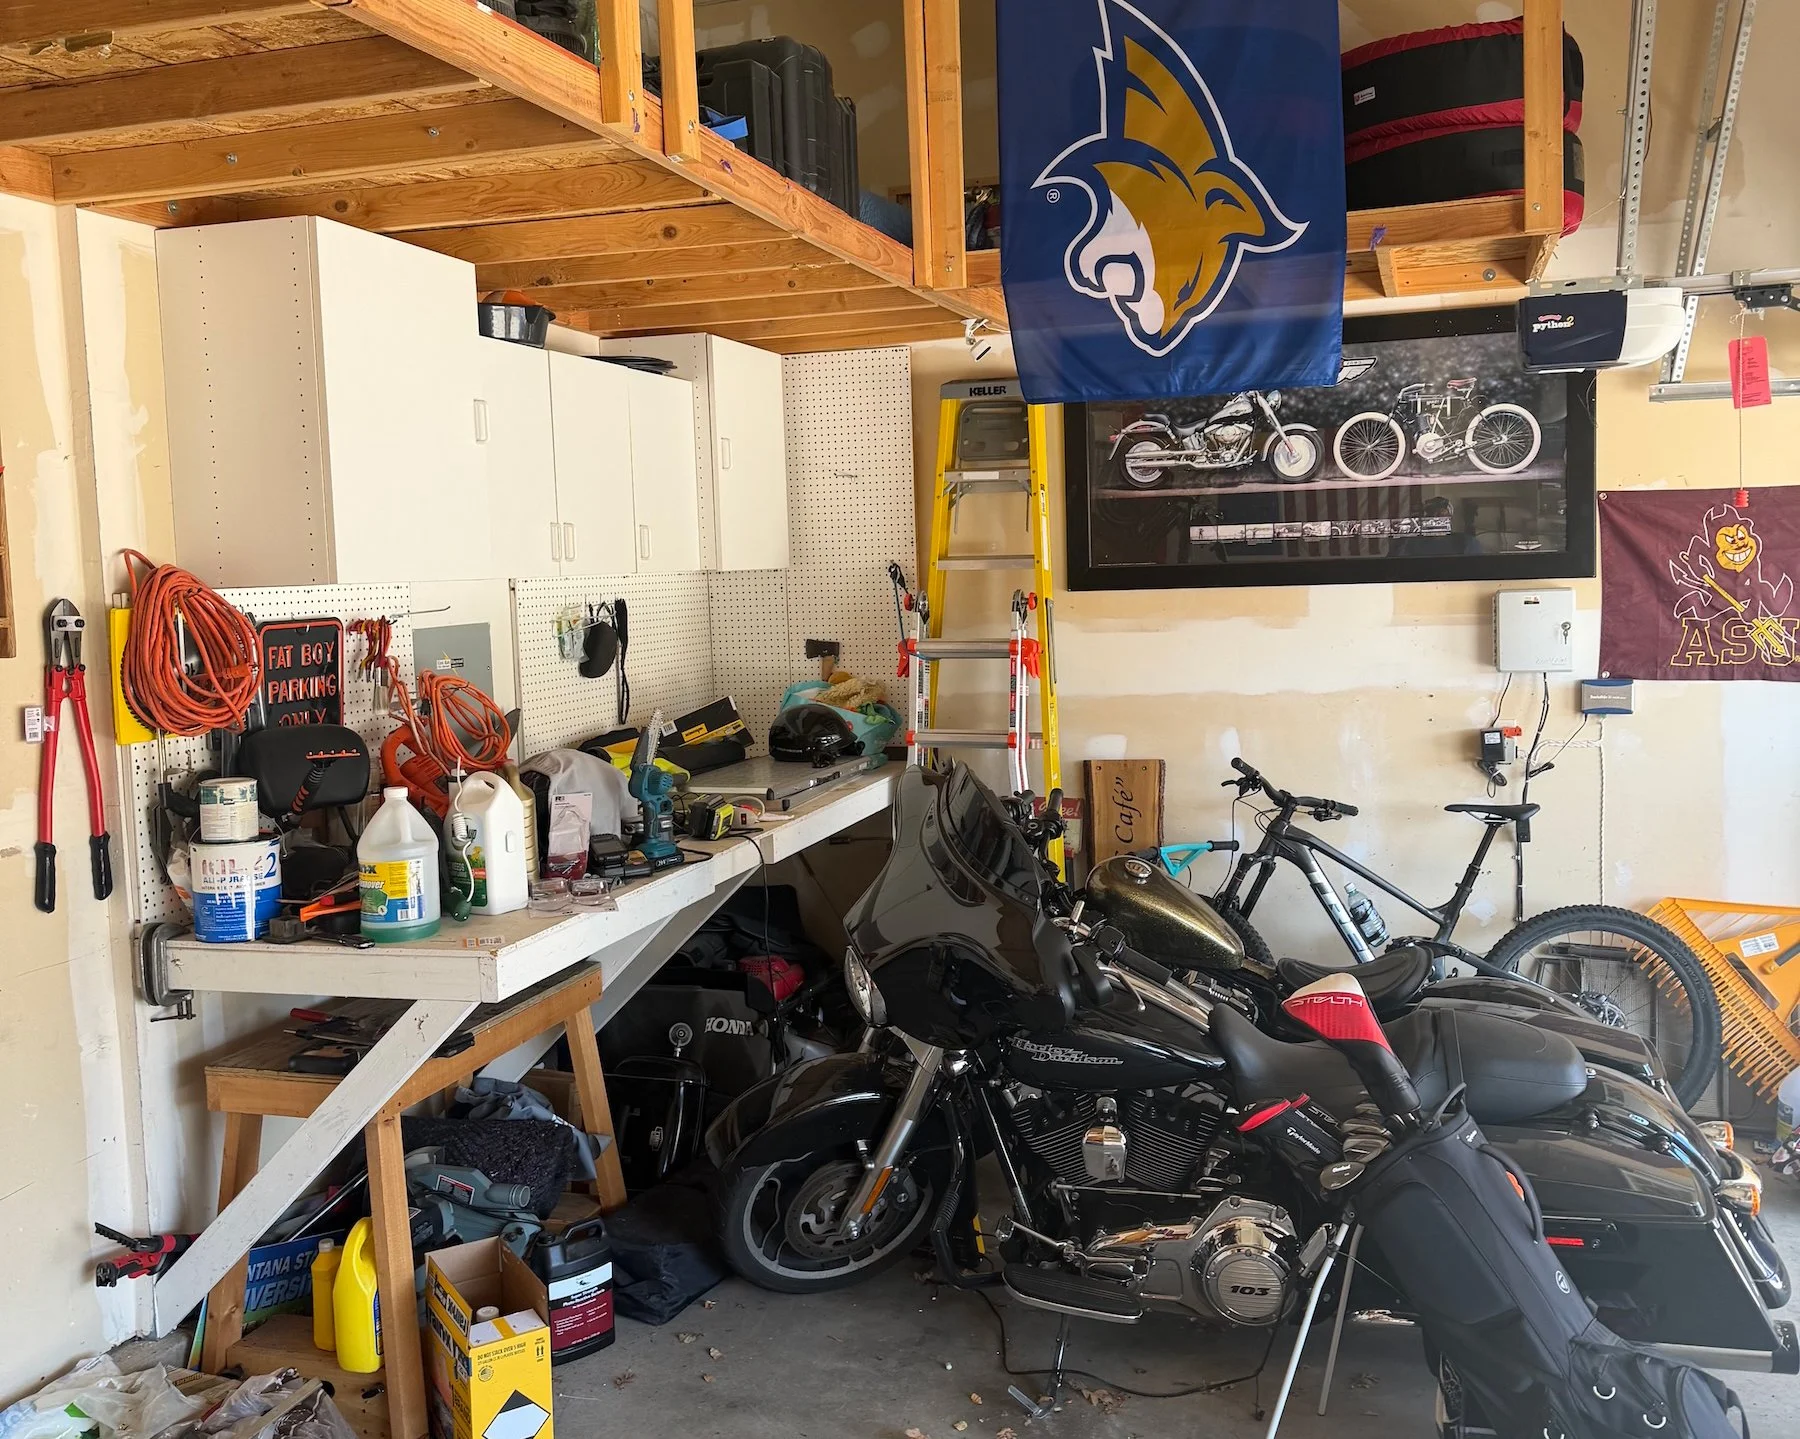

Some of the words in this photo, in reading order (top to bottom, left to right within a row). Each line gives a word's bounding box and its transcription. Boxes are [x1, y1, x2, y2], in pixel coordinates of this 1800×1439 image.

[969, 385, 1007, 397] KELLER
[268, 645, 294, 670] FAT
[301, 641, 335, 666] BOY
[268, 673, 337, 705] PARKING
[1290, 996, 1363, 1008] STEALTH
[704, 1016, 754, 1036] HONDA
[1286, 1126, 1321, 1155] TaylorMade
[247, 1256, 291, 1282] NTANA
[1230, 1285, 1271, 1296] 103
